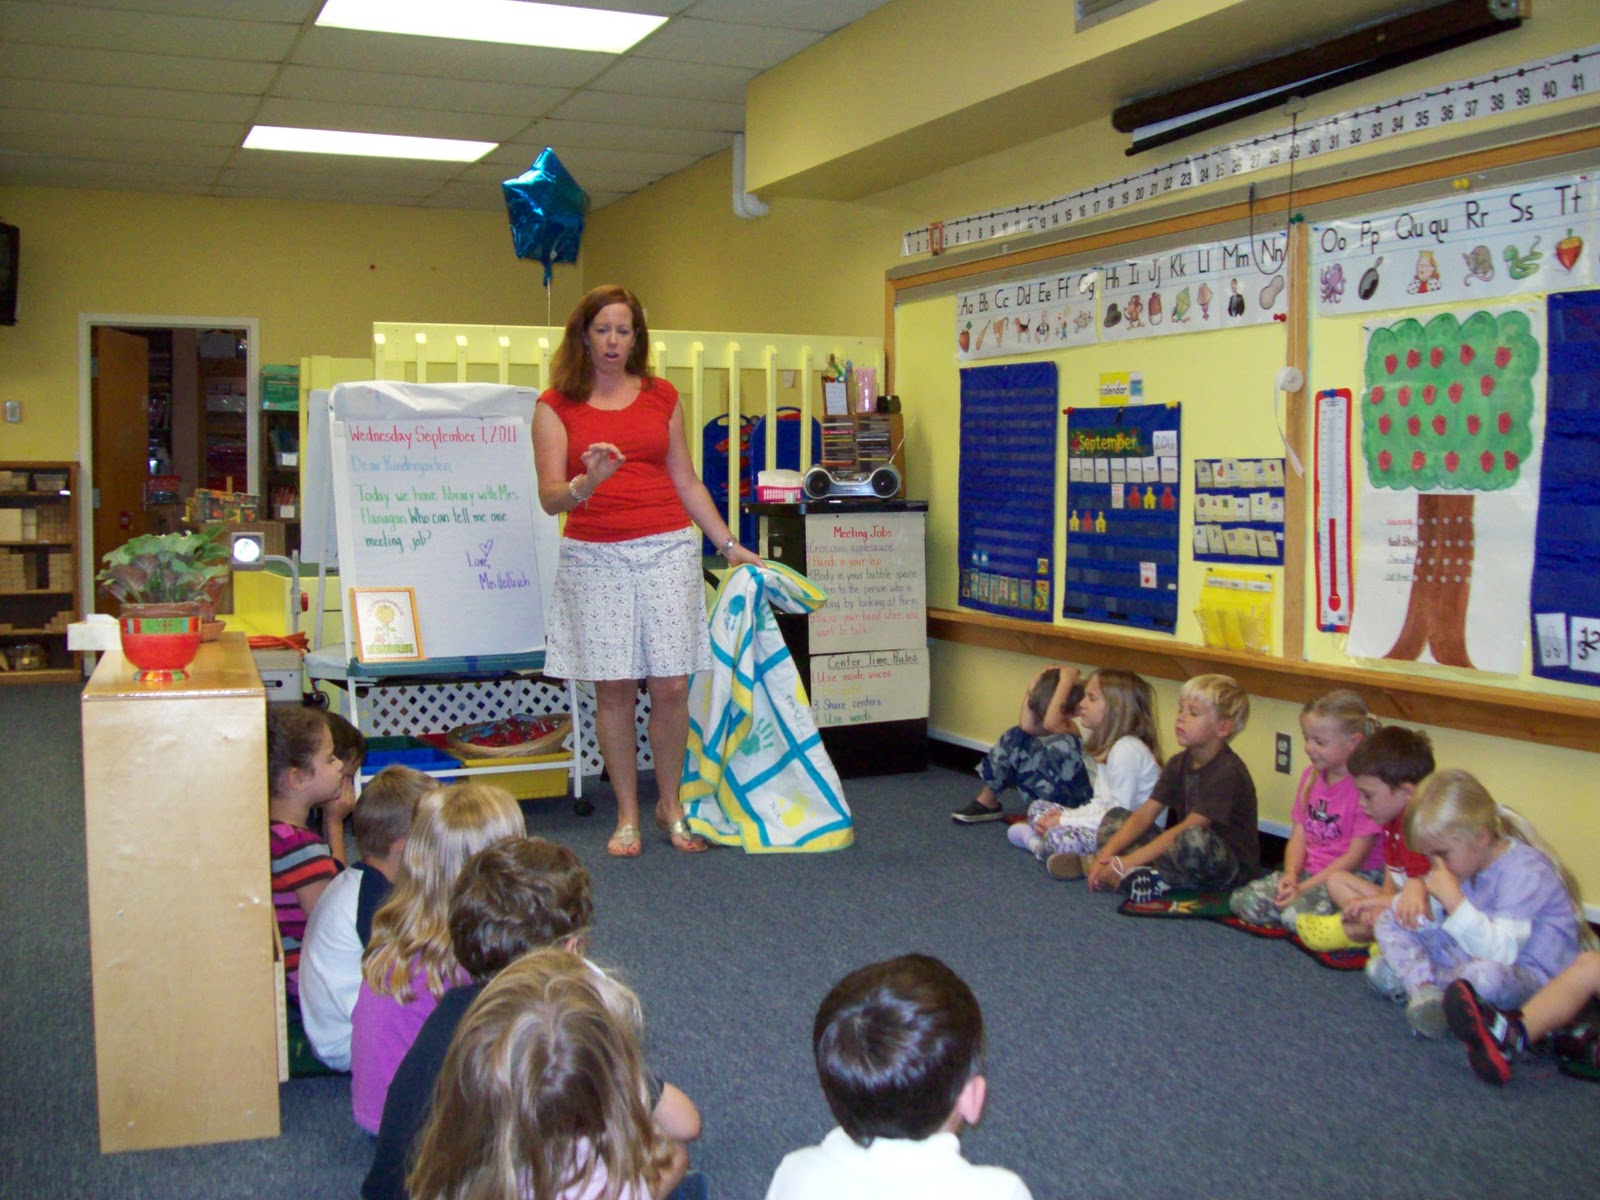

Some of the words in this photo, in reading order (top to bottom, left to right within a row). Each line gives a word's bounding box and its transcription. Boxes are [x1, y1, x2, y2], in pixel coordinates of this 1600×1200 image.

[967, 229, 972, 242] 7
[978, 227, 983, 239] 8
[990, 224, 995, 236] 9
[1040, 217, 1047, 230] 13
[1052, 212, 1059, 226] 14
[1065, 208, 1072, 222] 15
[1079, 204, 1086, 218] 16
[1093, 200, 1100, 214] 17
[1108, 196, 1114, 209] 18
[1122, 192, 1129, 204] 19
[1136, 187, 1144, 200] 20
[1150, 183, 1158, 196] 21
[1164, 177, 1172, 190] 22
[1180, 173, 1192, 186] 23
[1200, 168, 1209, 182] 24
[1216, 162, 1224, 178] 25
[1232, 158, 1242, 174] 26
[1250, 154, 1260, 168] 27
[1269, 148, 1280, 164] 28
[1288, 144, 1300, 160] 29
[1309, 138, 1320, 154] 30
[1329, 133, 1340, 149] 31
[1350, 128, 1362, 144] 32
[1370, 122, 1383, 138] 33
[1392, 116, 1404, 132] 34
[1415, 110, 1429, 128] 35
[1440, 104, 1454, 122] 36
[1464, 99, 1478, 118] 37
[1490, 92, 1504, 110] 38
[1516, 86, 1530, 106] 39
[1542, 80, 1558, 98] 40
[1571, 72, 1585, 92] 41
[1321, 228, 1347, 252] Oo
[1360, 220, 1380, 254] Pp
[1395, 212, 1423, 240] Qu
[1429, 218, 1448, 244] qu
[1465, 200, 1489, 230] Rr
[1509, 193, 1534, 223] Ss
[1554, 184, 1584, 216] Tt
[1105, 266, 1120, 290] Hh
[1148, 258, 1160, 288] Jj
[1170, 254, 1186, 278] Kk
[1198, 248, 1210, 273] Ll
[1223, 244, 1250, 270] Mm
[1261, 238, 1284, 264] Nn
[960, 296, 974, 316] Aa
[979, 292, 990, 312] Bb
[994, 288, 1009, 308] Cc
[1016, 284, 1032, 306] Dd
[1038, 282, 1051, 302] Ee
[1058, 276, 1071, 299] Ff
[1100, 382, 1127, 396] calendar
[349, 424, 412, 450] Wednesday
[415, 425, 475, 450] September
[1080, 434, 1138, 454] September
[352, 454, 379, 472] Dear
[354, 484, 390, 508] Today
[395, 492, 408, 502] we
[412, 485, 437, 501] have
[442, 485, 474, 507] library
[478, 484, 497, 500] with
[408, 507, 430, 524] Who
[432, 512, 450, 524] can
[452, 506, 470, 524] tell
[472, 512, 486, 522] me
[490, 512, 508, 522] one
[366, 530, 404, 554] meeting
[411, 530, 432, 551] job?
[834, 526, 868, 542] Meeting
[870, 525, 892, 538] Jobs
[466, 551, 491, 569] Love,
[847, 573, 864, 583] your
[896, 570, 917, 582] space
[838, 584, 846, 594] to
[848, 583, 860, 594] the
[864, 584, 888, 597] person
[890, 582, 904, 592] who
[844, 596, 854, 610] by
[859, 597, 886, 610] looking
[887, 595, 896, 606] at
[842, 613, 859, 623] your
[862, 610, 881, 620] hand
[884, 610, 904, 620] when
[906, 612, 920, 621] you
[816, 627, 834, 637] want
[840, 624, 848, 636] to
[828, 654, 862, 669] Center
[866, 652, 888, 666] Time
[892, 650, 918, 664] Rules
[817, 672, 838, 682] Use
[843, 669, 864, 680] inside
[868, 670, 892, 679] voices
[823, 698, 846, 710] Share
[852, 696, 882, 708] centers
[824, 712, 842, 724] Use
[849, 710, 872, 722] words
